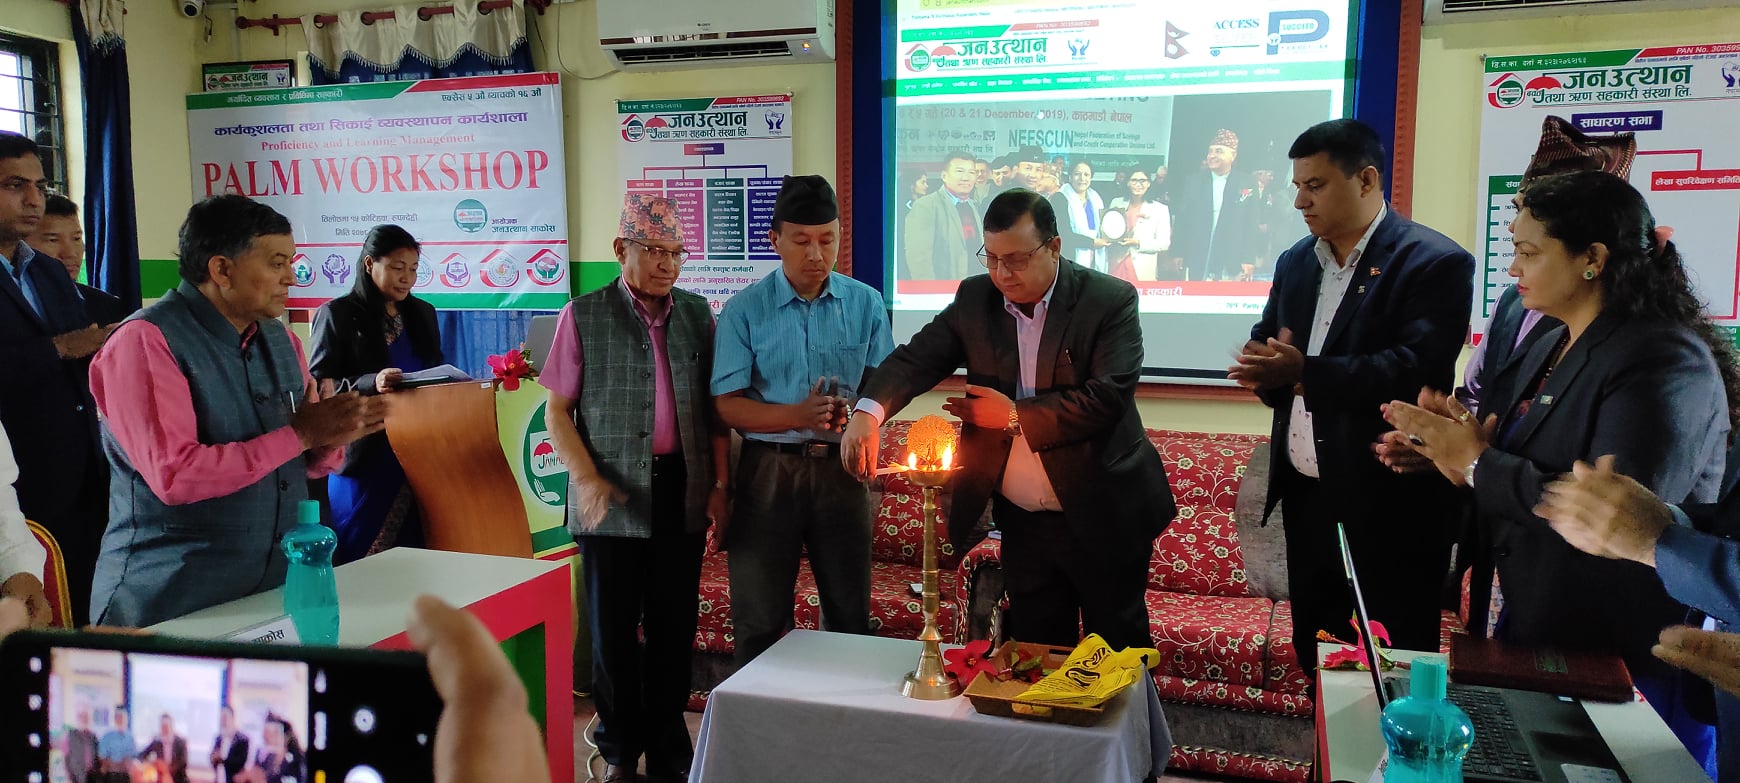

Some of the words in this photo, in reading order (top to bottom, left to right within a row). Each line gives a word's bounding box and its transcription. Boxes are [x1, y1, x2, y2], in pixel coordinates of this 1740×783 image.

[1214, 18, 1260, 30] ACCESS
[1563, 64, 1694, 90] जनउत्थान
[1545, 92, 1565, 104] तथा
[1596, 86, 1639, 101] सहकारी
[1642, 86, 1671, 99] संस्था
[214, 123, 294, 137] कार्यकुशलता
[299, 121, 325, 133] तथा
[377, 115, 452, 128] व्यवस्थापन
[457, 112, 528, 125] कार्यशाला
[668, 111, 749, 129] जनउत्थान
[1580, 116, 1625, 129] साधारण
[1628, 115, 1653, 127] सभा
[689, 127, 716, 138] सहकारी
[261, 139, 319, 152] Proficiency
[323, 137, 343, 149] and
[346, 136, 397, 148] Learning
[400, 133, 475, 147] Management
[202, 158, 304, 198] PALM
[312, 149, 549, 195] WORKSHOP
[530, 223, 556, 233] साकोस
